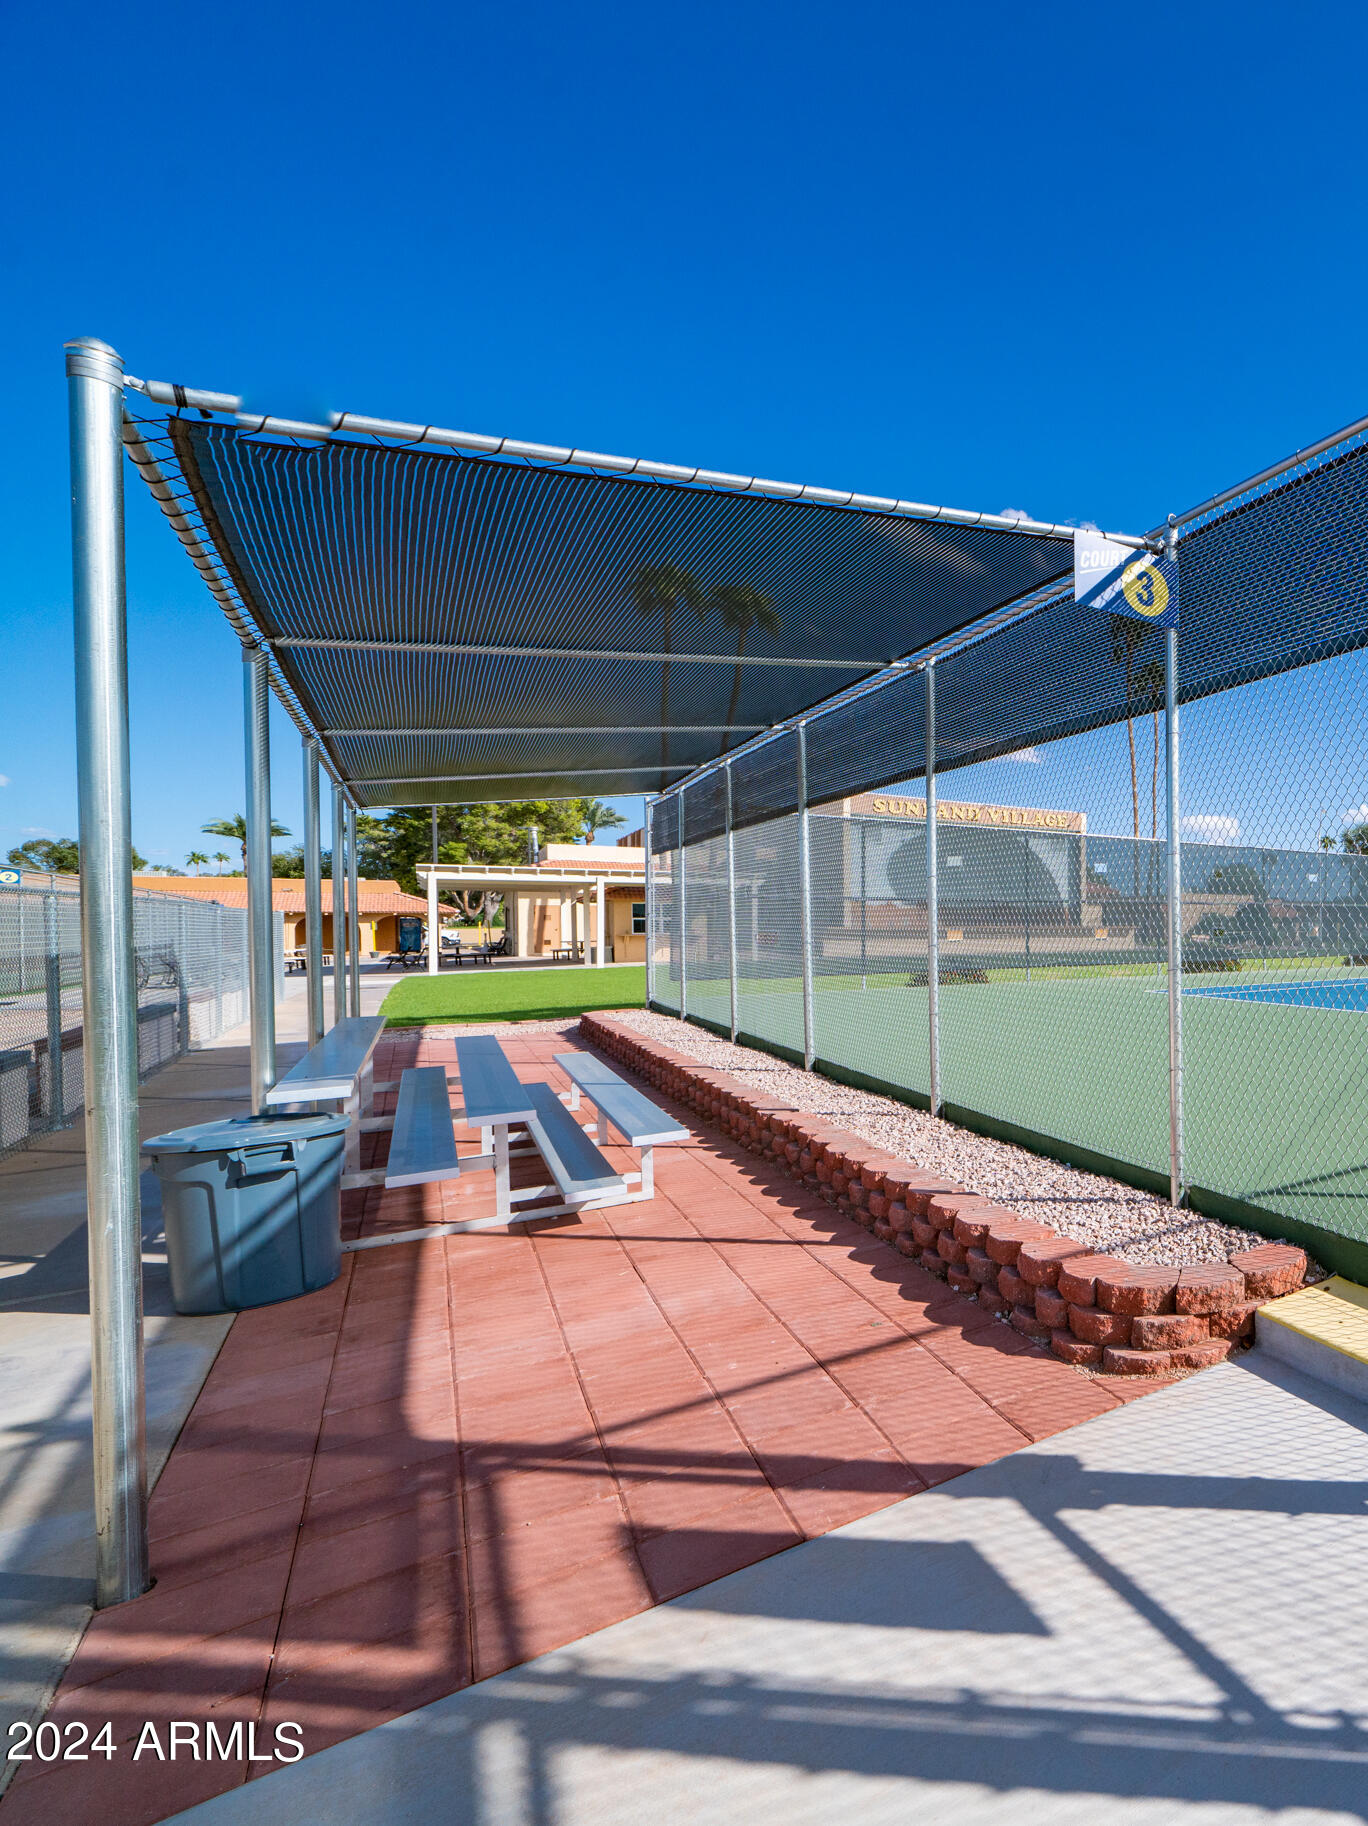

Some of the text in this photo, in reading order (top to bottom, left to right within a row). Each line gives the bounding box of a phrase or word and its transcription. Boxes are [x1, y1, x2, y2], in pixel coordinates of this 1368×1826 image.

[1136, 571, 1155, 607] 3
[988, 808, 1070, 828] VILLAGE
[5, 873, 12, 881] 2
